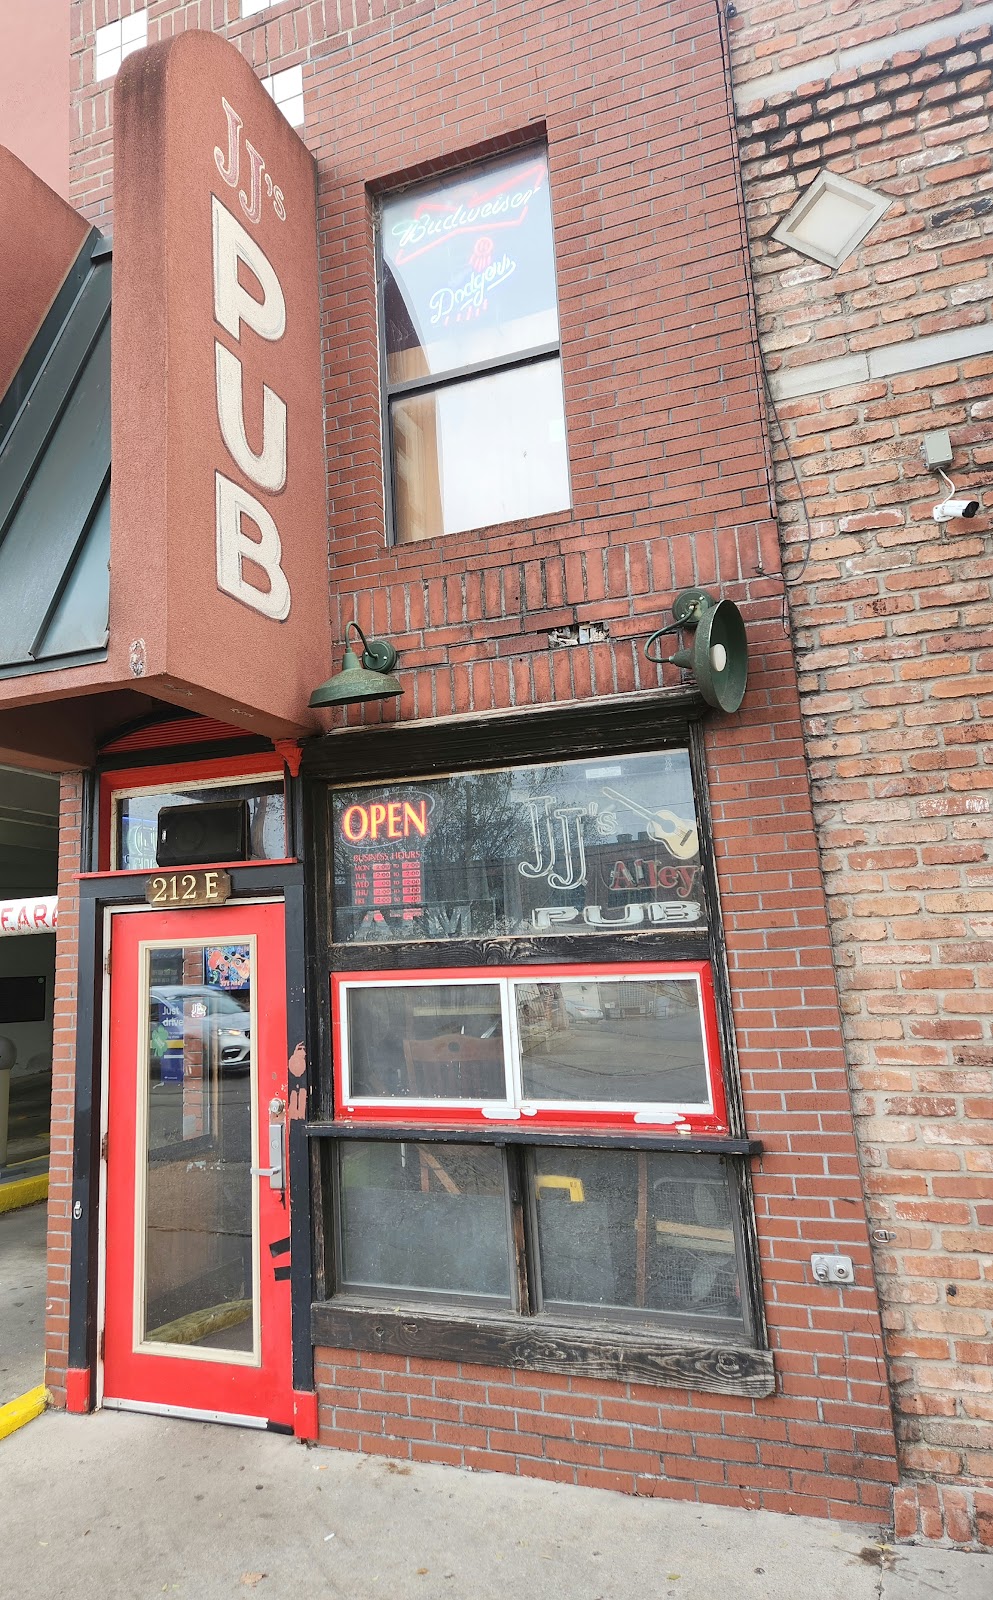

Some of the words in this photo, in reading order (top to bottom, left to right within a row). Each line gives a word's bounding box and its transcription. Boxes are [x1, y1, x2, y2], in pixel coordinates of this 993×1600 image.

[391, 185, 541, 247] Budweiser
[429, 253, 517, 324] Dodgers
[209, 191, 293, 624] PUB
[342, 800, 427, 842] OPEN
[353, 852, 389, 862] BUSINESS
[391, 850, 421, 860] HOURS
[151, 874, 197, 902] 212
[204, 871, 219, 899] E
[609, 858, 704, 898] Alley
[532, 901, 703, 930] PUB
[161, 1006, 180, 1016] Just
[161, 1017, 184, 1027] drive
